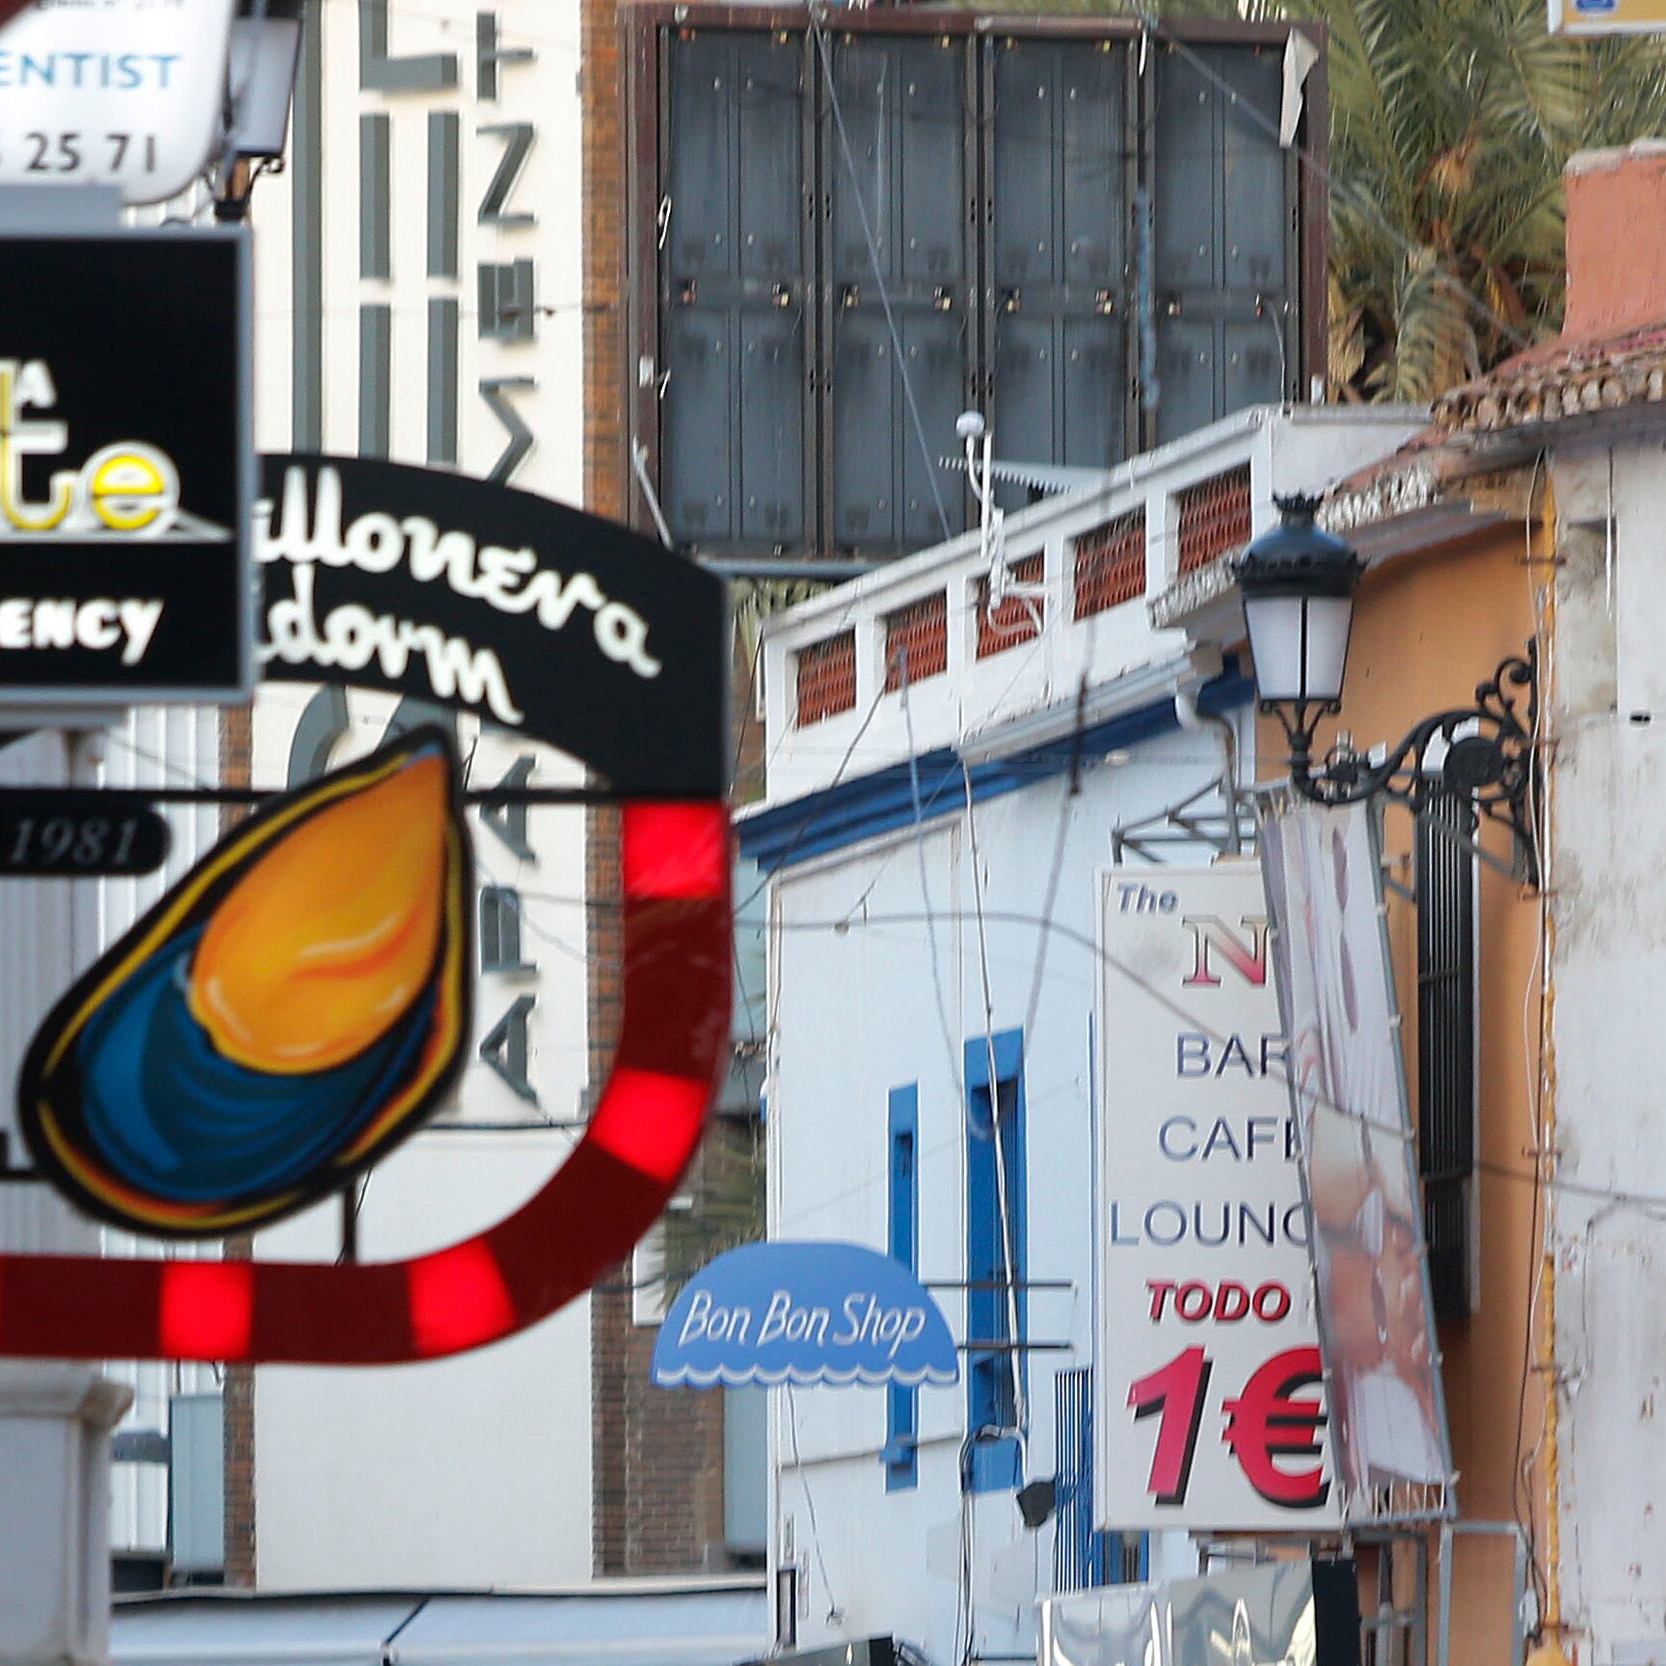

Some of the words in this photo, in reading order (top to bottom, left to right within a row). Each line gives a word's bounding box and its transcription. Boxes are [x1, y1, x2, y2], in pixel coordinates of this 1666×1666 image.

[26, 132, 81, 172] 25
[106, 134, 157, 173] 71
[10, 816, 140, 864] 1981
[1114, 883, 1177, 916] The
[678, 1289, 751, 1347] Bon
[756, 1290, 830, 1347] Bon
[833, 1292, 927, 1360] Shop
[1146, 1279, 1291, 1324] TODO
[1127, 1343, 1331, 1510] 1€
